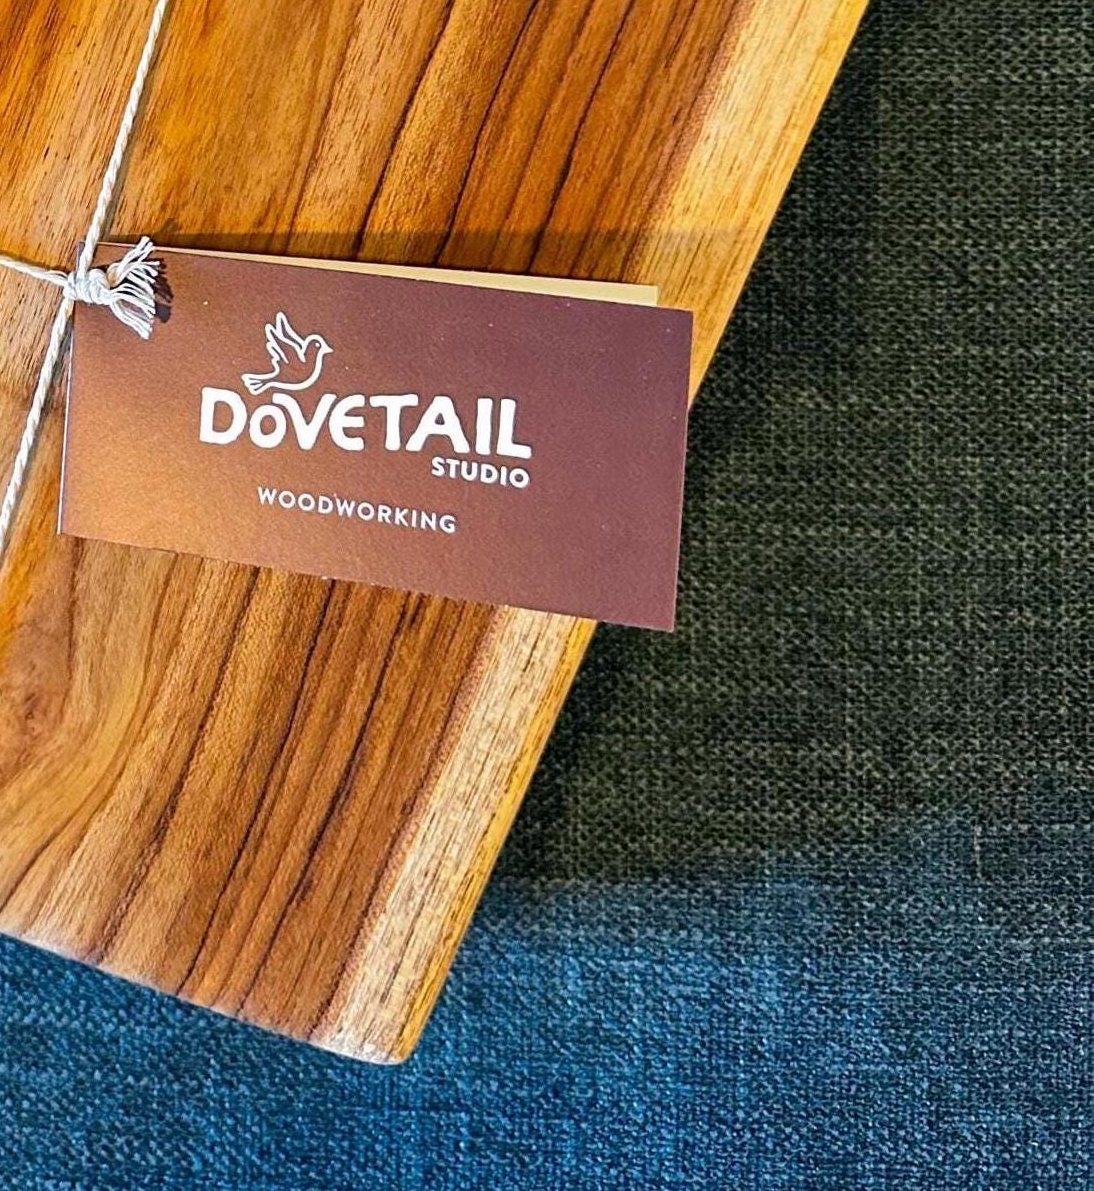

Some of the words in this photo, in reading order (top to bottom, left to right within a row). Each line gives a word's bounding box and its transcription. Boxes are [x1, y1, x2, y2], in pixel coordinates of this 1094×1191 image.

[199, 386, 532, 459] DOVETAIL
[431, 456, 531, 489] STUDIO
[257, 486, 457, 534] WOODWORKING
